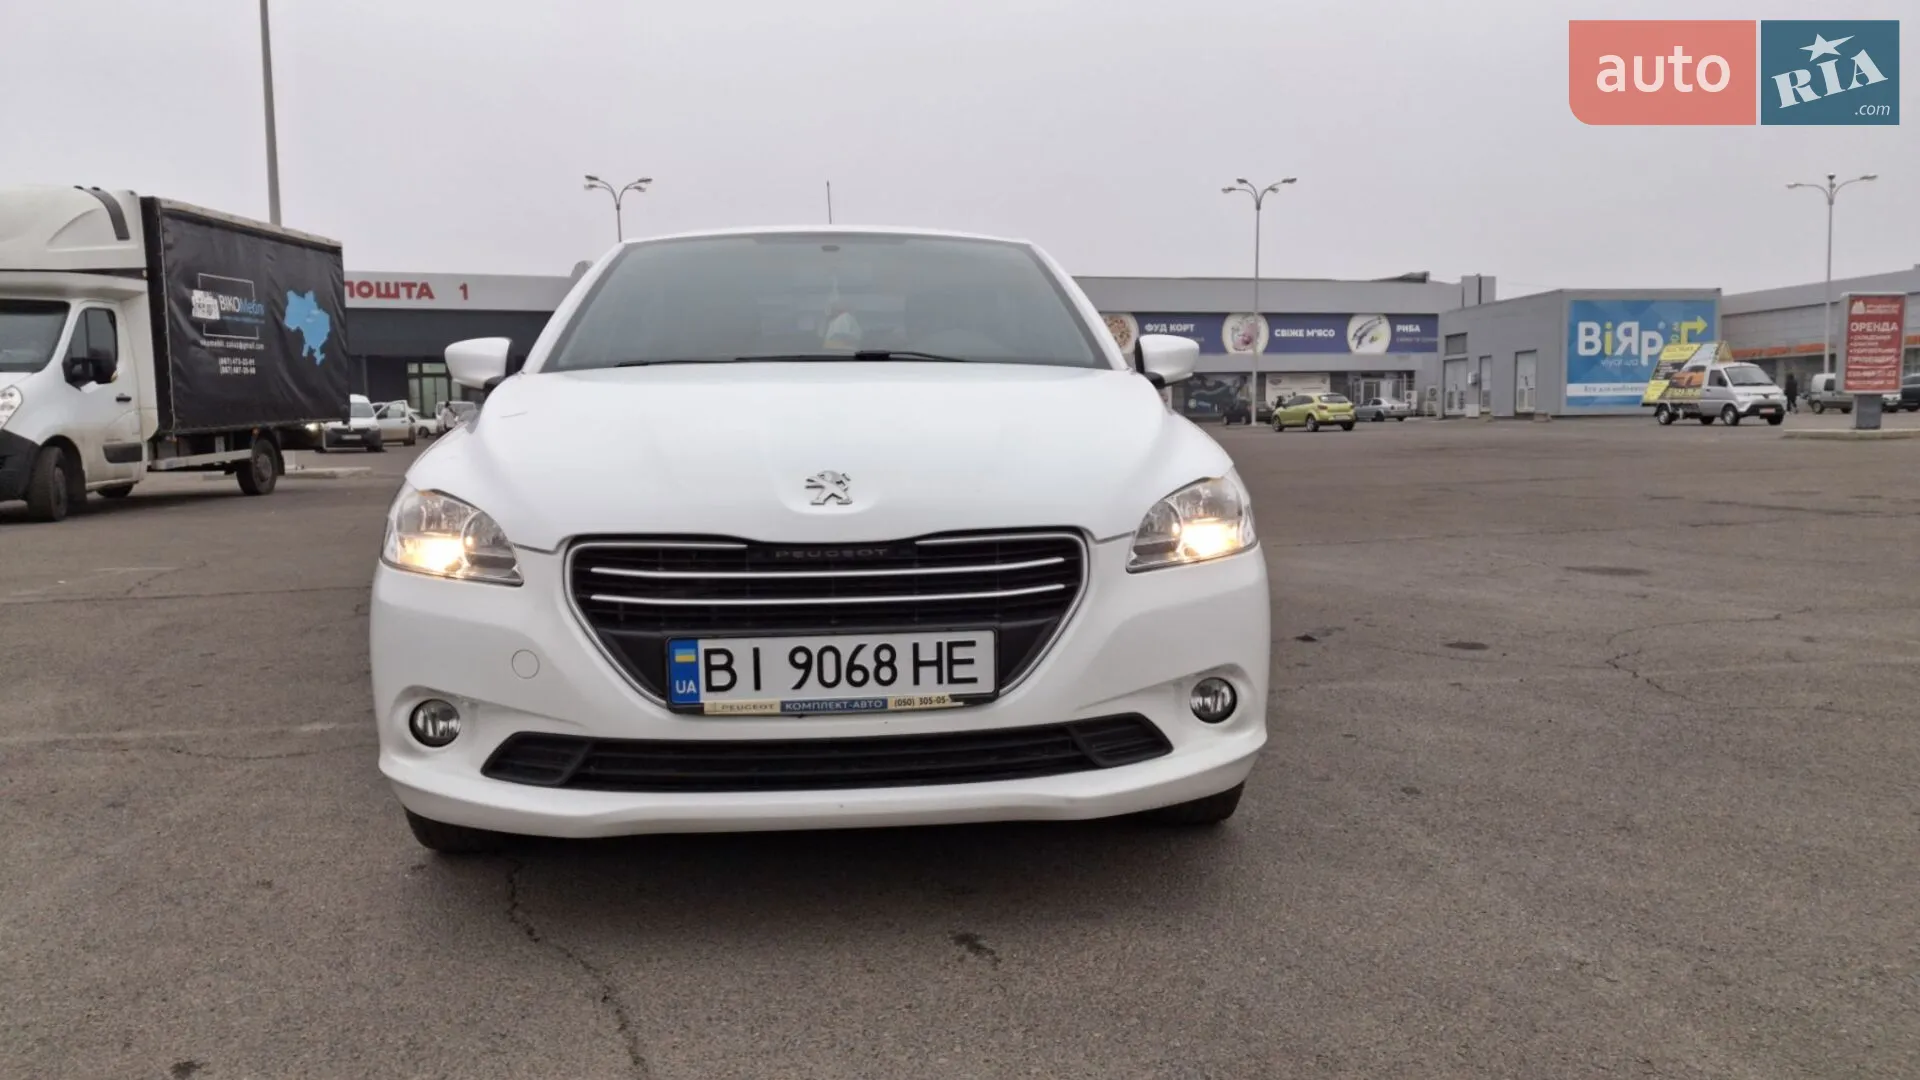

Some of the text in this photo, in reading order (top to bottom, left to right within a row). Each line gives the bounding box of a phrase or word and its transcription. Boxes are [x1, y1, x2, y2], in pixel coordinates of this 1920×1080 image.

[459, 283, 468, 300] 1
[1144, 323, 1195, 333] ФУД КОРТ
[1396, 324, 1421, 333] РИБА
[1850, 321, 1899, 332] ОРЕНДА
[1274, 328, 1305, 338] СВІЖЕ
[775, 548, 888, 559] PEUGEOT
[788, 643, 898, 690] 9068
[912, 640, 978, 686] HE
[675, 680, 697, 694] UA
[785, 699, 883, 711] КОМПЛЕКТ-АВТО
[894, 695, 951, 707] (050) 305-05-
[721, 703, 775, 712] PEUGEOT
